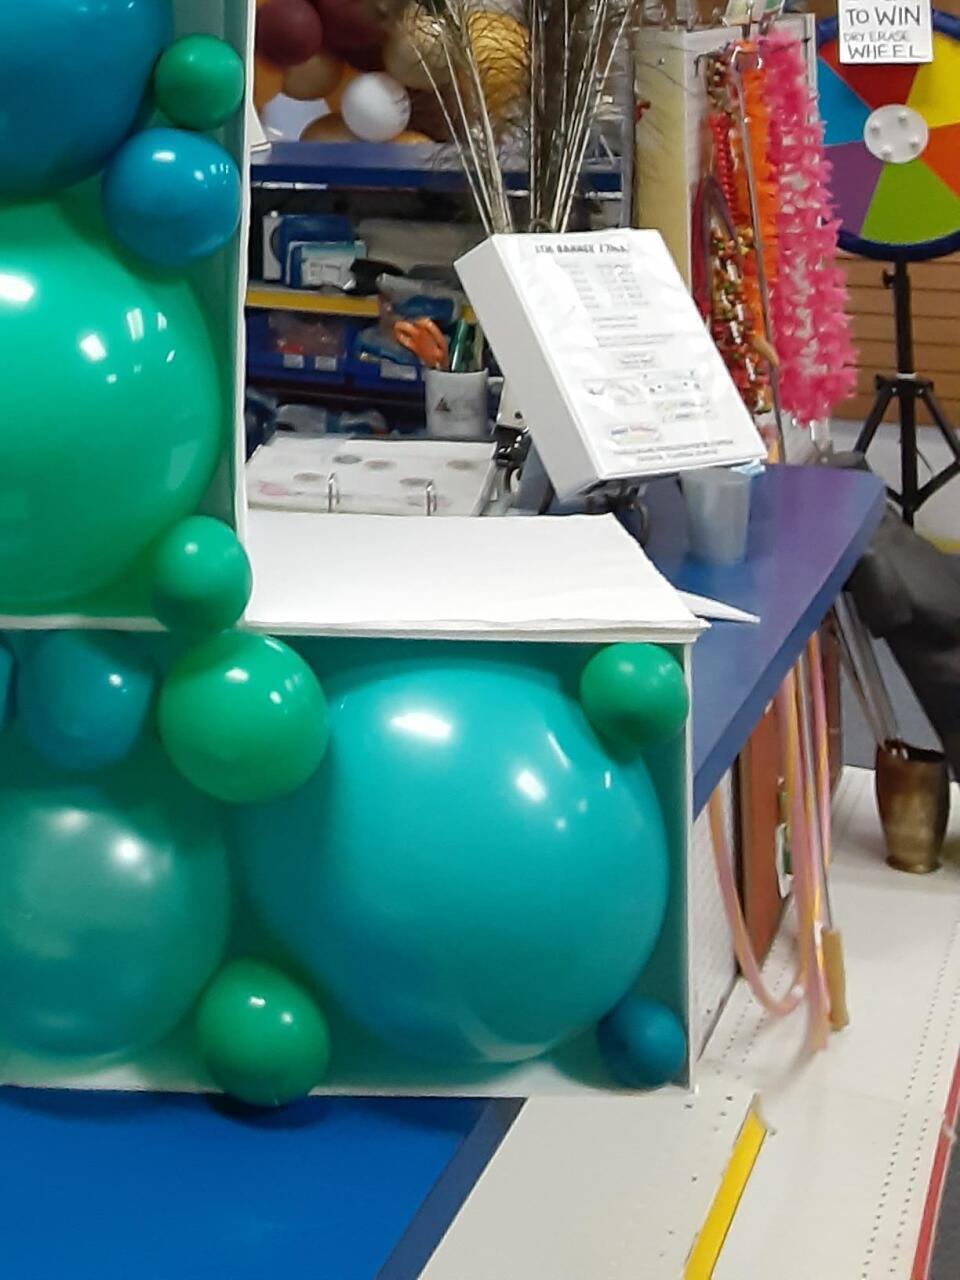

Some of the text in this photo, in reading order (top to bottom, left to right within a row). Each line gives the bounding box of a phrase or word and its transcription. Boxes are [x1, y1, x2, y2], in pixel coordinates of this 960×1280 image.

[845, 5, 921, 26] TO WIN
[847, 44, 929, 60] WHEEL
